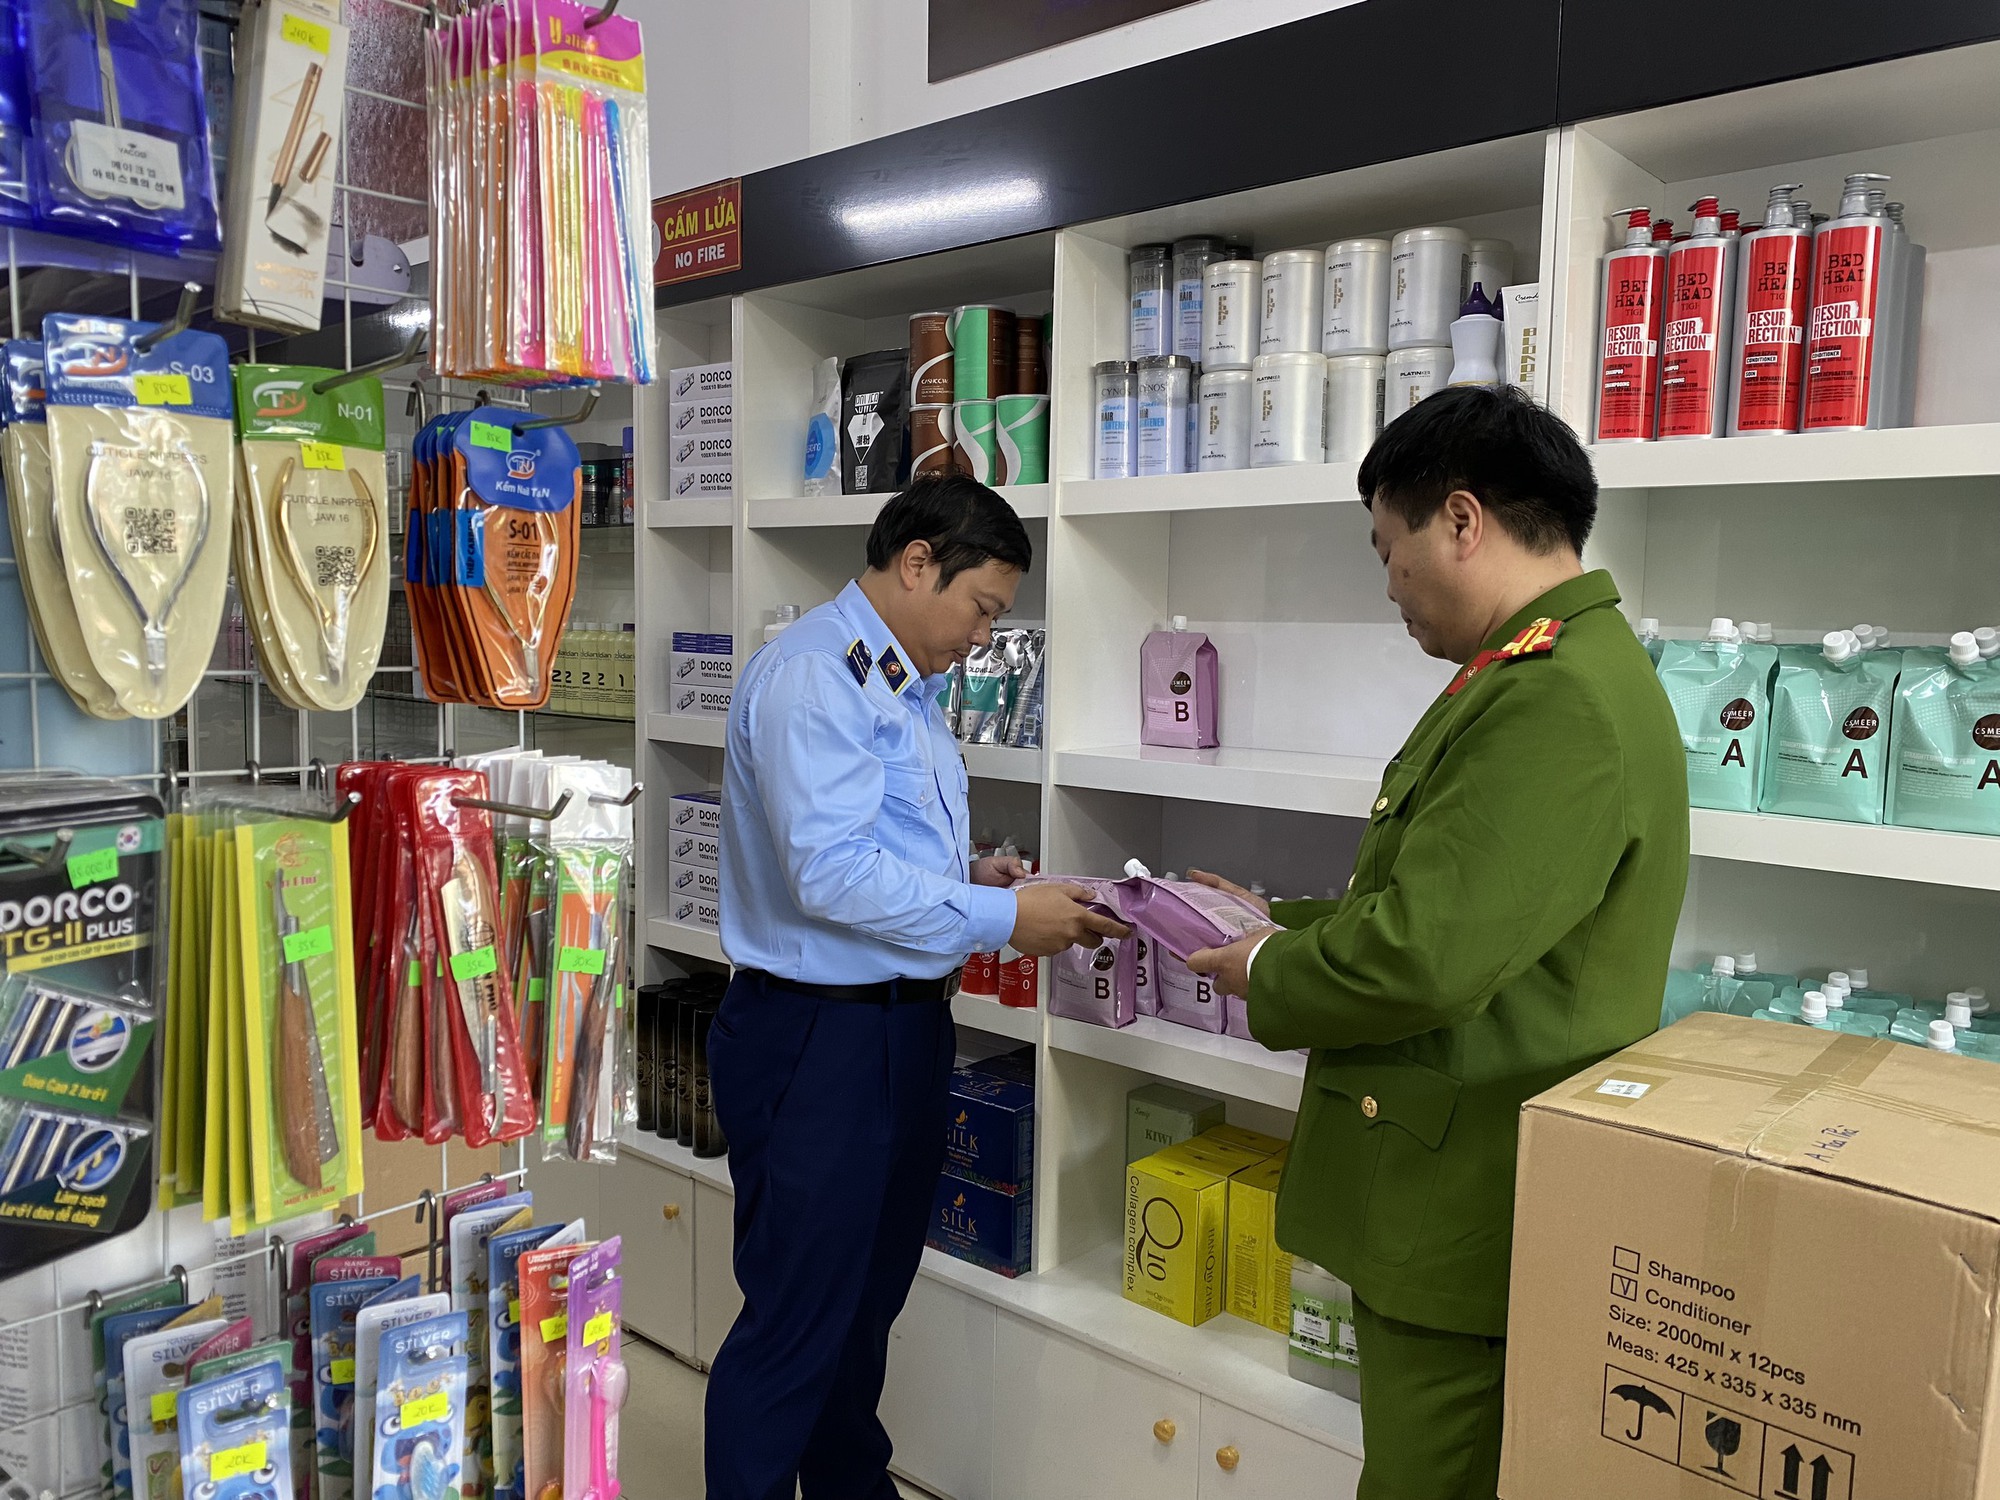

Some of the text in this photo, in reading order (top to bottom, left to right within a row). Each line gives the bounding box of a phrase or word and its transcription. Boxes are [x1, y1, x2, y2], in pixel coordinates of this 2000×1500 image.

[664, 196, 736, 241] CẤM LỬA
[675, 243, 726, 269] NO FIRE
[1829, 254, 1864, 270] BED
[1677, 273, 1708, 288] BED
[1673, 288, 1713, 303] HEAD
[1749, 311, 1787, 328] RESUR
[1814, 303, 1852, 323] RESUR
[1608, 326, 1641, 342] RESUR
[1666, 321, 1696, 337] RESUR
[1813, 320, 1861, 339] RECTION
[1665, 335, 1707, 352] RECTION
[170, 361, 215, 384] S-03
[700, 370, 732, 383] DORCO
[337, 402, 373, 422] N-01
[700, 405, 732, 418] DORCO
[252, 419, 322, 431] New Technology
[700, 439, 732, 451] DORCO
[86, 446, 208, 465] CUTICLE NIPPERS
[128, 469, 154, 481] JAW
[700, 472, 732, 484] DORCO
[284, 494, 329, 506] CUTICLE
[314, 511, 350, 523] JAW 16
[508, 518, 538, 541] S-01
[700, 660, 732, 672] DORCO
[551, 670, 561, 682] 2
[565, 671, 571, 683] 2
[582, 672, 590, 684] 2
[598, 673, 604, 685] 2
[619, 674, 624, 687] 1
[718, 672, 732, 680] Blades
[700, 692, 732, 705] DORCO
[1175, 701, 1190, 722] B
[1722, 710, 1753, 718] CSMEER
[1844, 719, 1877, 727] CSMEER
[1975, 727, 2000, 735] CSME
[1721, 738, 1746, 768] A
[1841, 748, 1869, 779] A
[1977, 759, 2000, 790] A
[0, 883, 134, 932] DORCO
[5, 921, 83, 957] TG-II
[87, 917, 134, 941] PLUS
[983, 968, 990, 979] 0
[1136, 965, 1148, 987] B
[1022, 979, 1031, 990] 0
[1095, 977, 1111, 999] B
[1196, 980, 1212, 1004] B
[1144, 1128, 1173, 1147] KIWI
[941, 1207, 977, 1234] SILK
[1126, 1174, 1140, 1291] Collagen complex
[344, 1260, 371, 1268] NANO
[528, 1262, 553, 1275] years
[330, 1267, 385, 1281] SILVER
[1647, 1260, 1737, 1302] Shampoo
[1645, 1288, 1752, 1337] Conditioner
[395, 1330, 451, 1353] SILVER
[1608, 1303, 1806, 1386] Size: 2000ml x 12pcs
[152, 1341, 200, 1364] SILVE
[212, 1382, 245, 1396] NANO
[1606, 1331, 1863, 1437] Meas: 425 x 335 x 335 mm
[195, 1382, 262, 1415] SILVER
